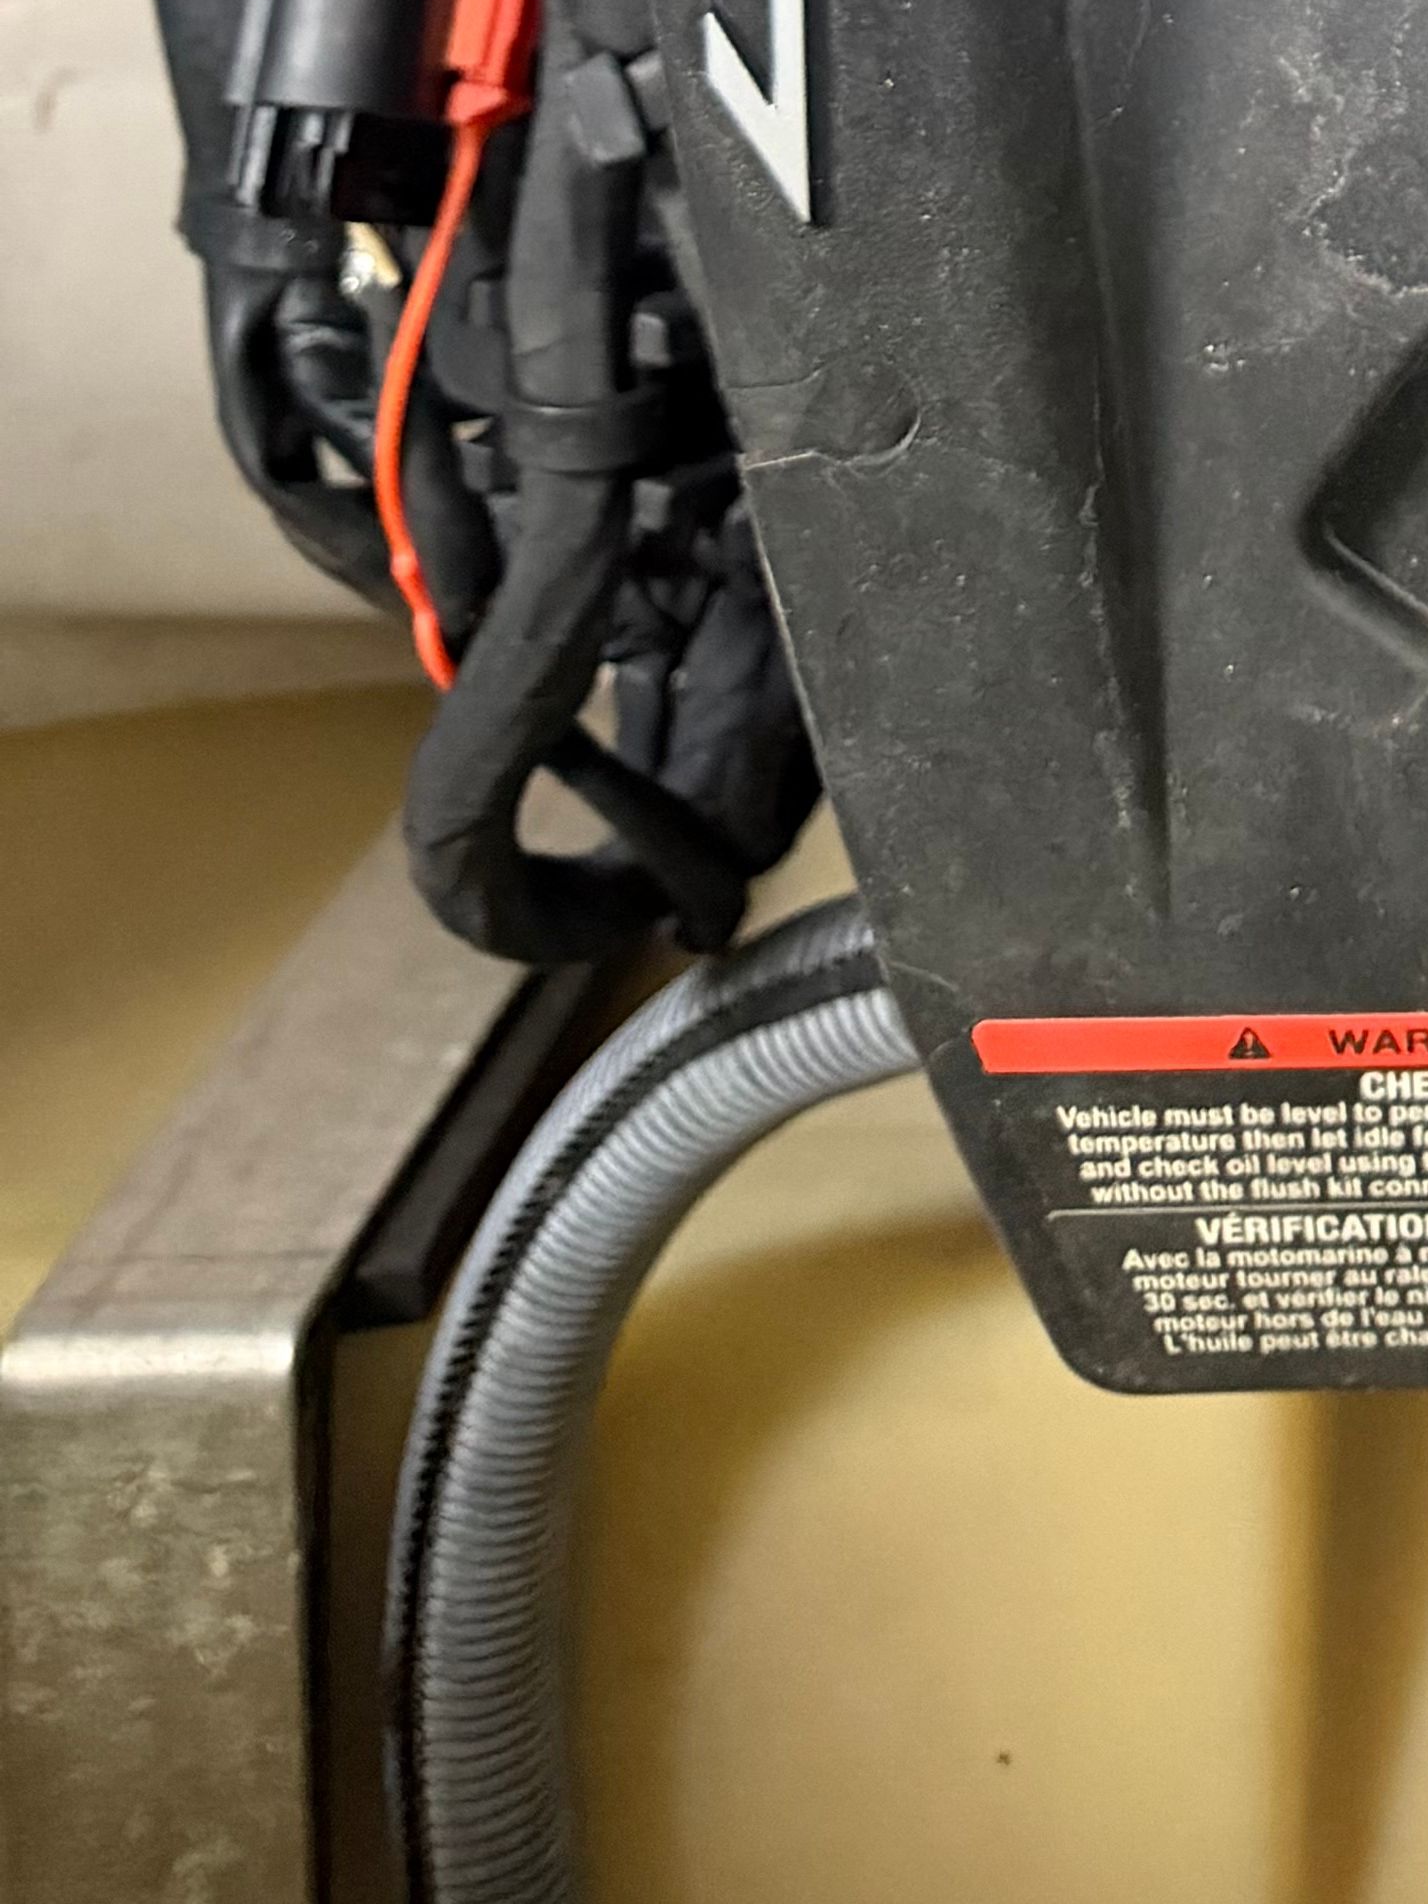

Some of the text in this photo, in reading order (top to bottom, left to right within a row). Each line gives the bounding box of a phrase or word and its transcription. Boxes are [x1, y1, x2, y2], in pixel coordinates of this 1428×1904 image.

[1056, 1105, 1157, 1129] Vehicle
[1163, 1104, 1234, 1125] must
[1240, 1102, 1274, 1125] be
[1281, 1101, 1347, 1123] level
[1353, 1103, 1381, 1122] to
[1068, 1131, 1236, 1159] temperature
[1241, 1129, 1305, 1151] then
[1311, 1127, 1348, 1149] let
[1354, 1126, 1405, 1148] idle
[1079, 1156, 1132, 1181] and
[1138, 1155, 1220, 1178] check
[1225, 1154, 1261, 1176] oil
[1265, 1153, 1332, 1175] level
[1338, 1152, 1416, 1177] using
[1090, 1181, 1194, 1204] without
[1200, 1180, 1244, 1202] the
[1250, 1178, 1321, 1200] flush
[1326, 1177, 1363, 1199] kit
[1122, 1249, 1190, 1271] Avec
[1195, 1248, 1222, 1269] la
[1226, 1246, 1389, 1268] motomarine
[1395, 1245, 1413, 1264] à
[1133, 1271, 1230, 1291] moteur
[1235, 1268, 1336, 1289] tourner
[1342, 1268, 1378, 1286] au
[1143, 1292, 1177, 1313] 30
[1241, 1290, 1270, 1310] et
[1275, 1288, 1370, 1309] vérifier
[1375, 1286, 1399, 1307] le
[1154, 1313, 1249, 1334] moteur
[1254, 1310, 1315, 1330] hors
[1320, 1308, 1354, 1328] de
[1361, 1306, 1424, 1327] l'eau
[1260, 1330, 1319, 1353] peut
[1324, 1328, 1378, 1348] être
